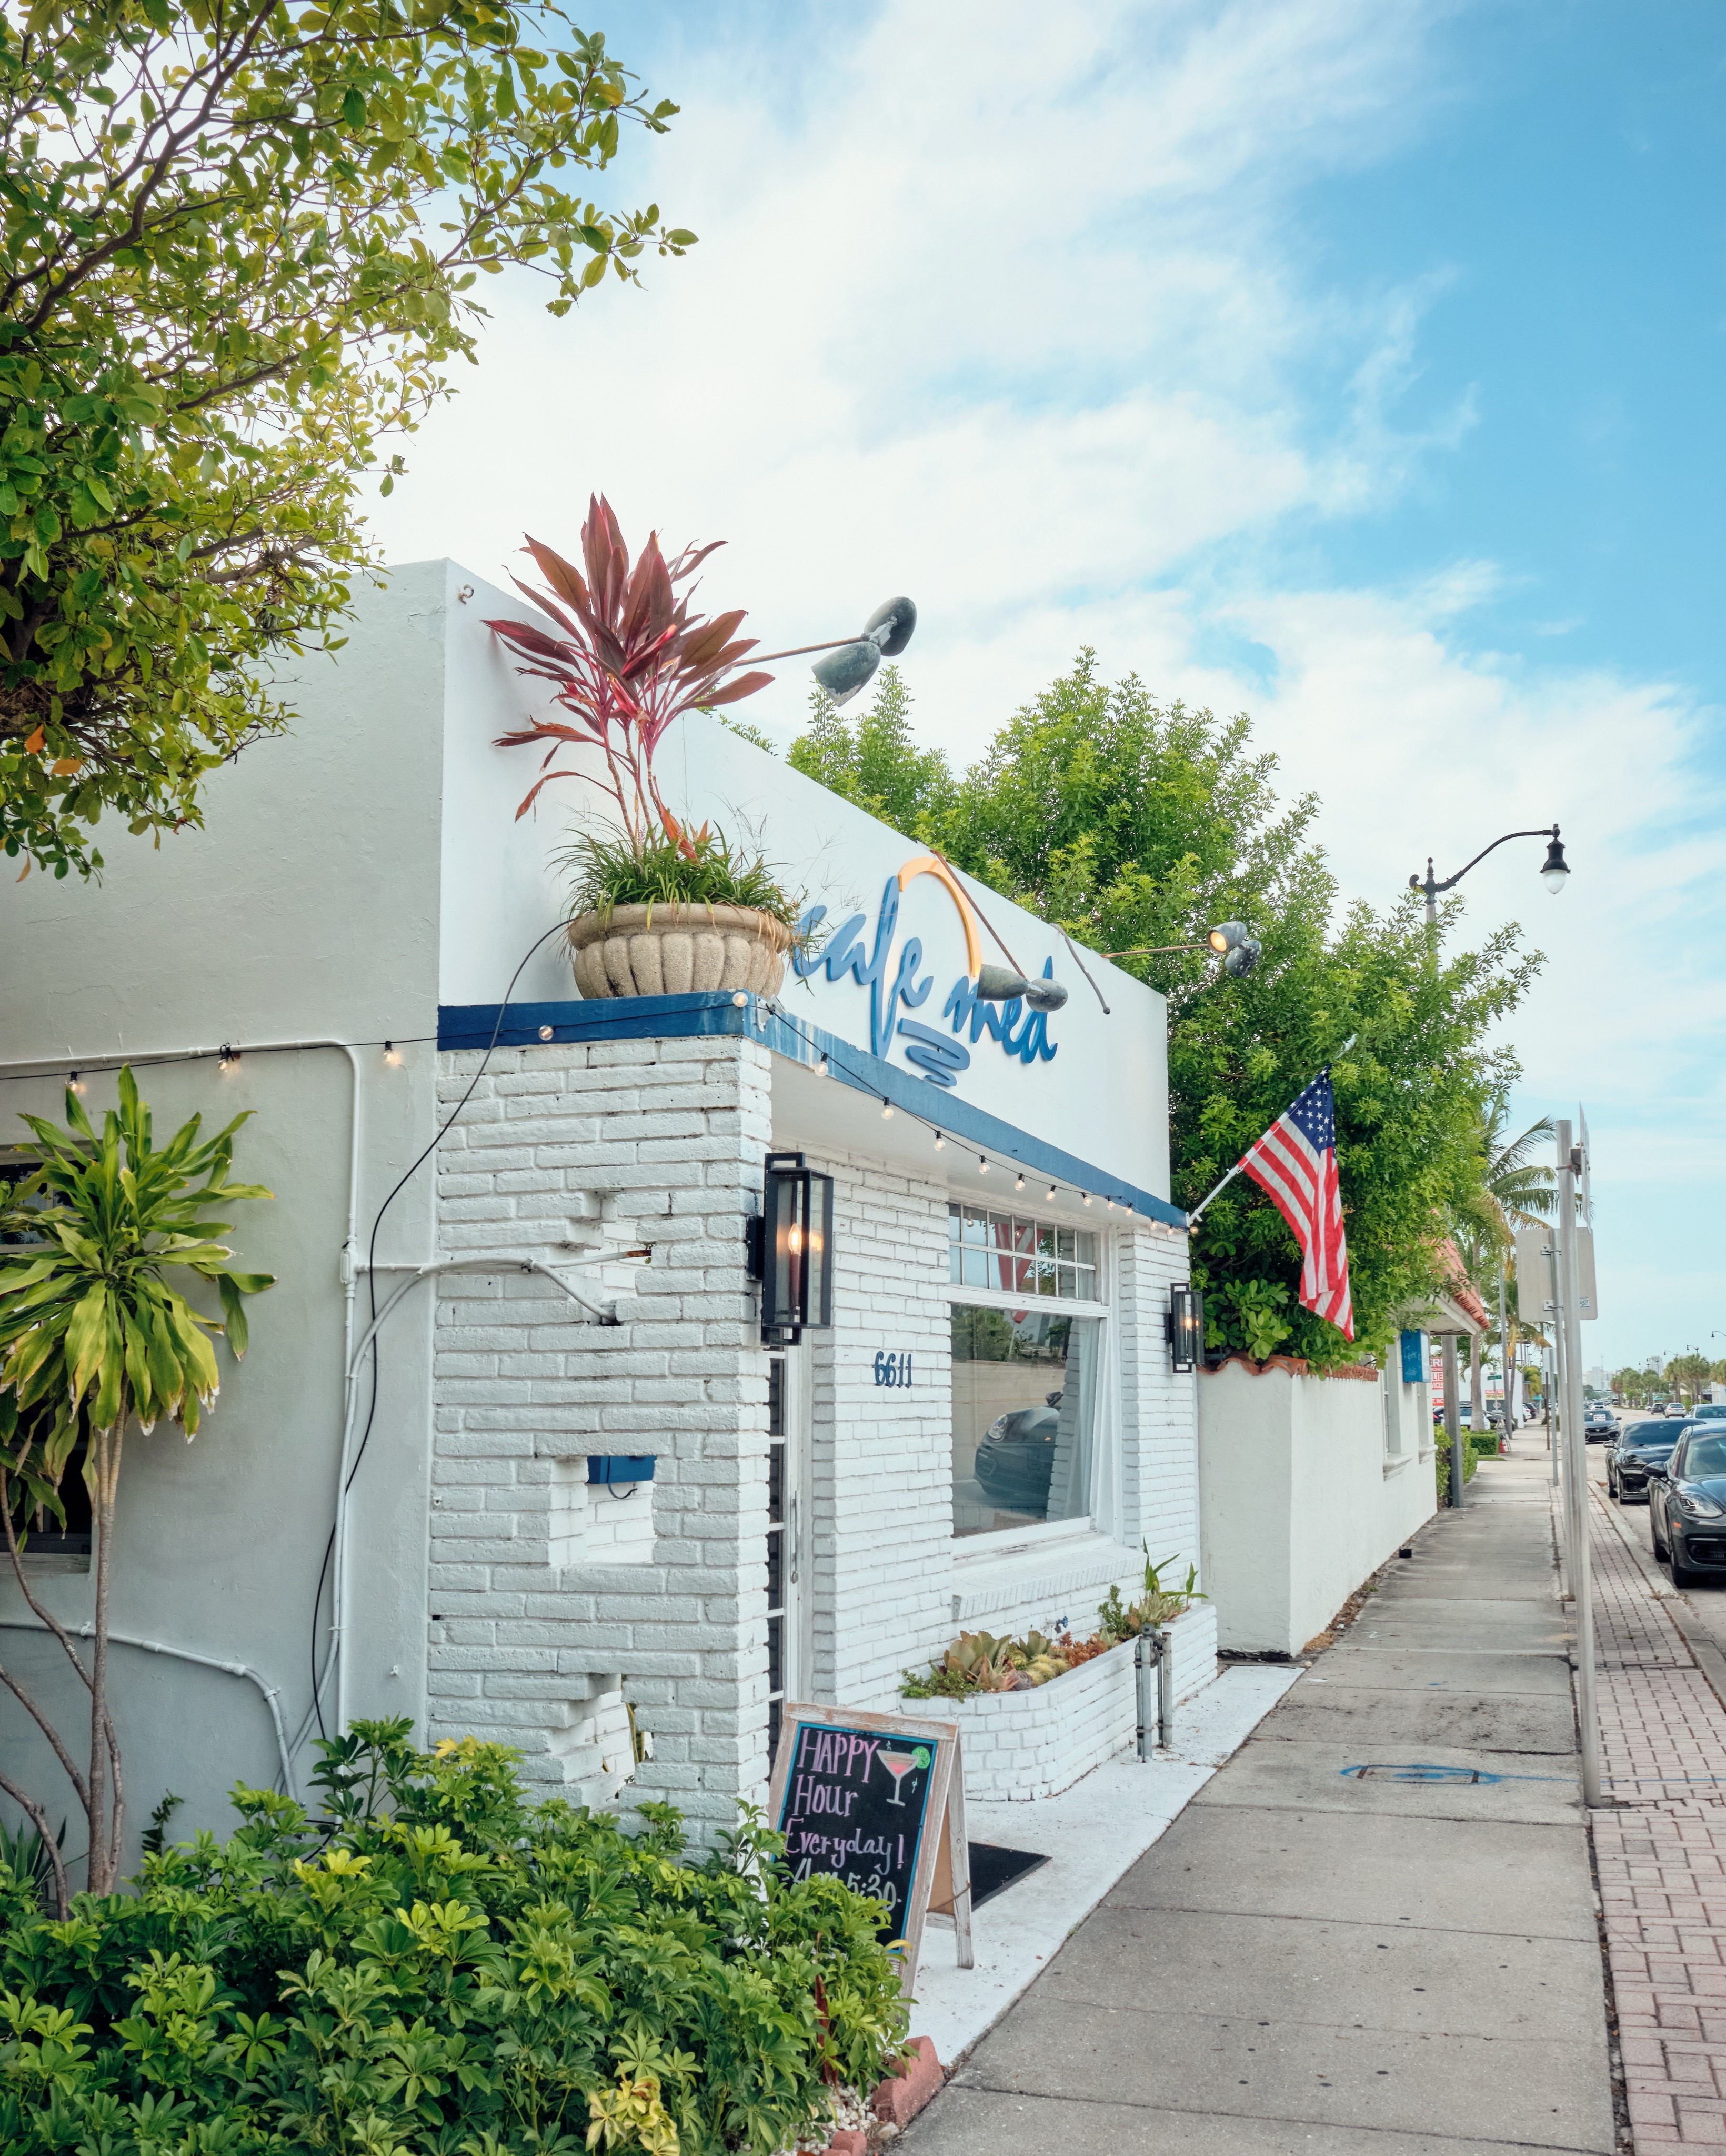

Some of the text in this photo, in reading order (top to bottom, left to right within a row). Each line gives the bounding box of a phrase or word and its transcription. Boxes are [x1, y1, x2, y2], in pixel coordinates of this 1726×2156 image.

[944, 955, 1058, 1064] med
[874, 1351, 912, 1388] 6611
[797, 1728, 881, 1783] HAPPY
